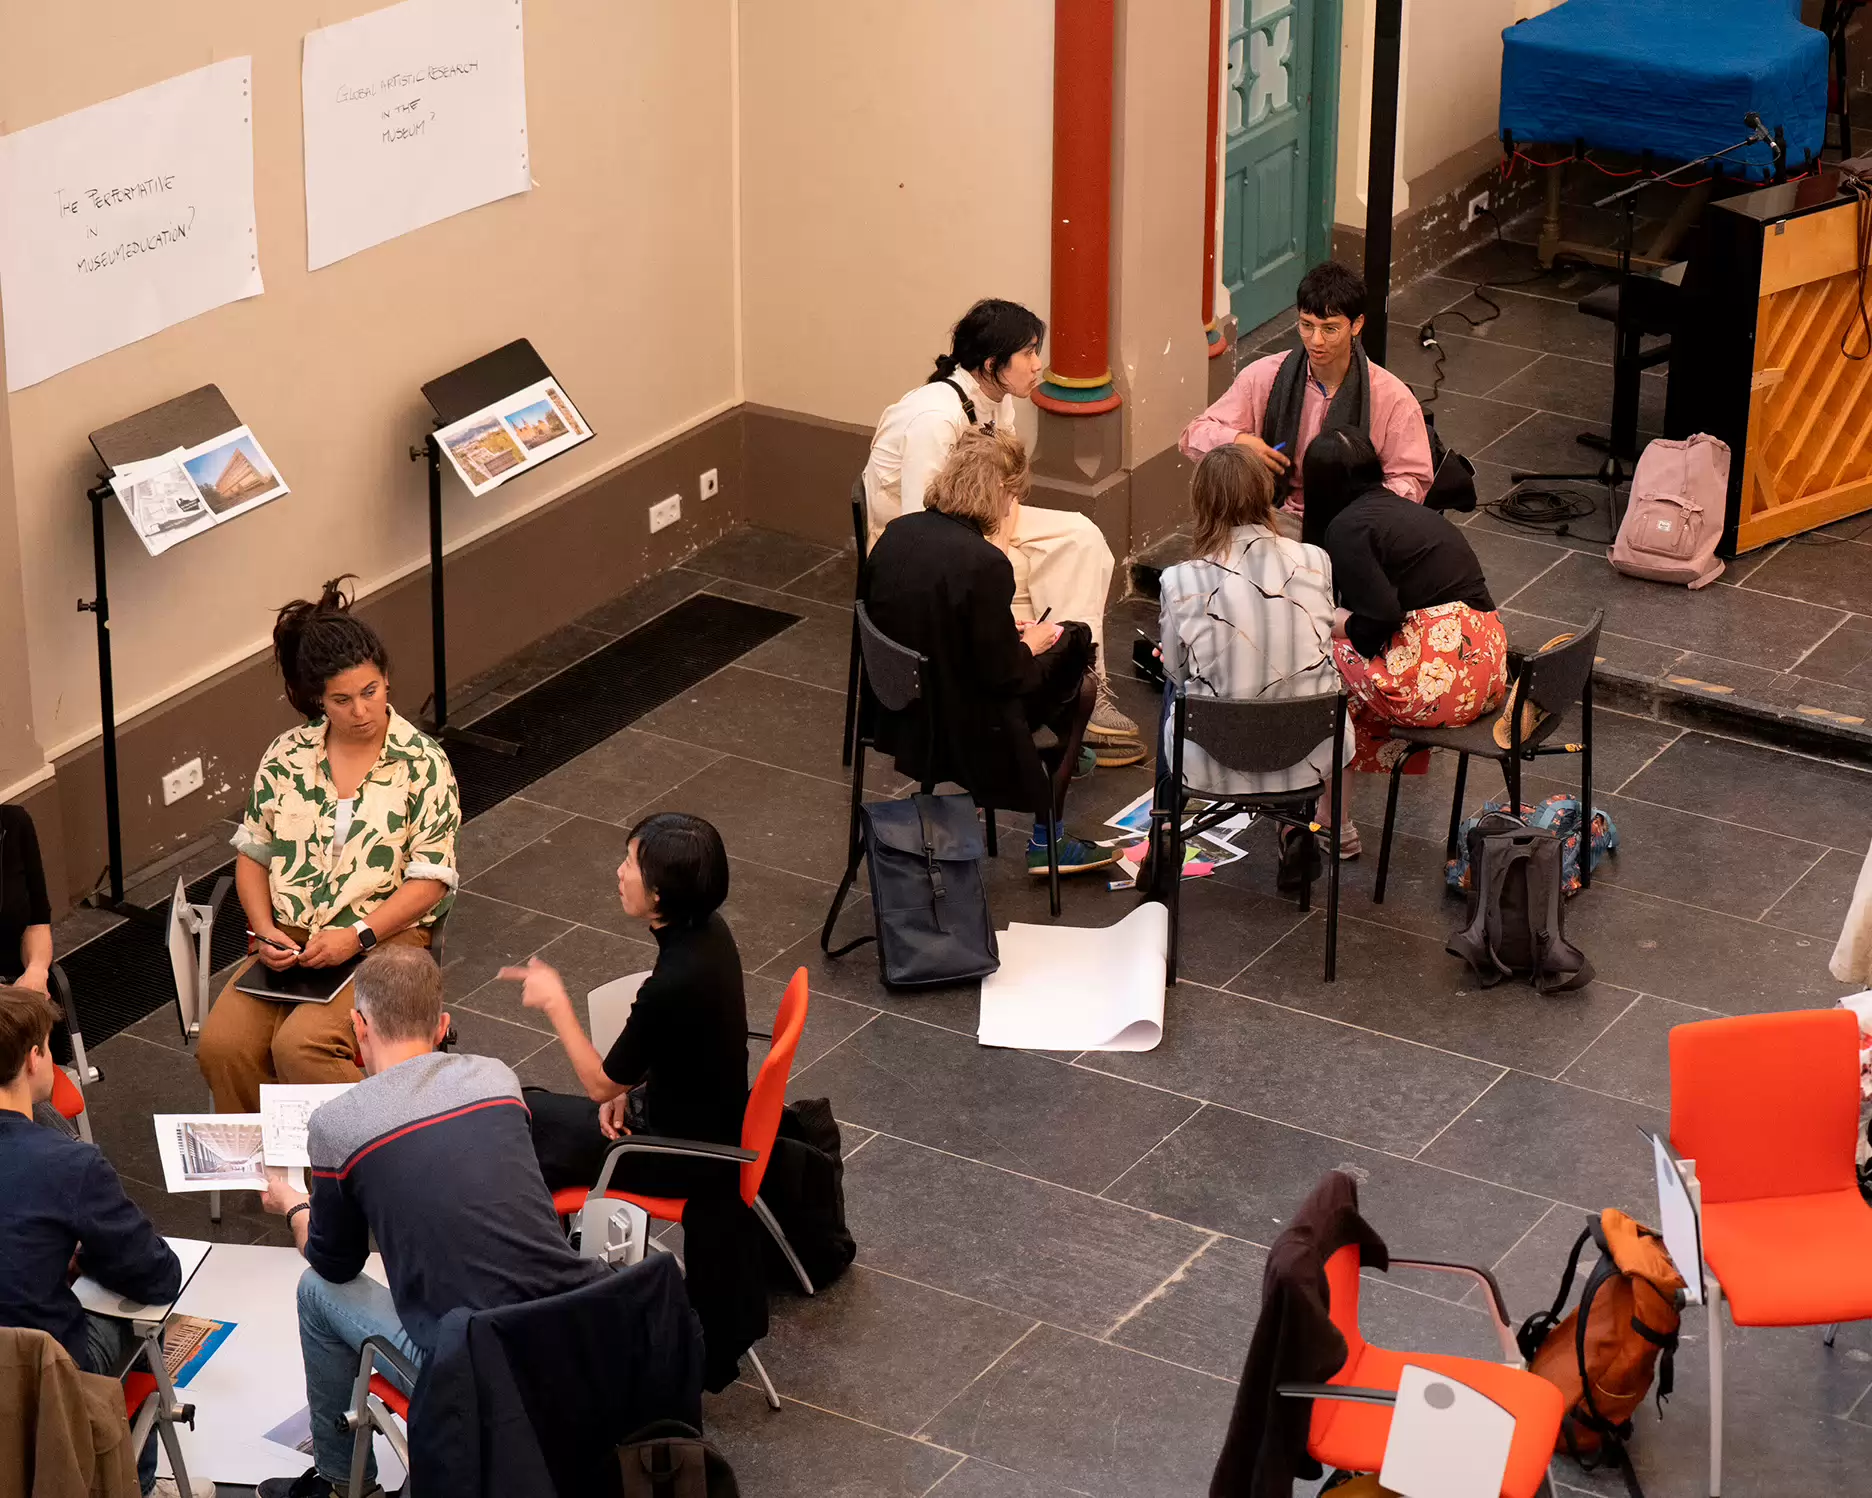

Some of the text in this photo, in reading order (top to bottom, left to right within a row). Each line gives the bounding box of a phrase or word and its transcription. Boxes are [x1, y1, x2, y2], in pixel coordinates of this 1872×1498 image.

[336, 60, 478, 103] GLOBAL ARTISTIC RESEARCH
[395, 98, 421, 113] THE
